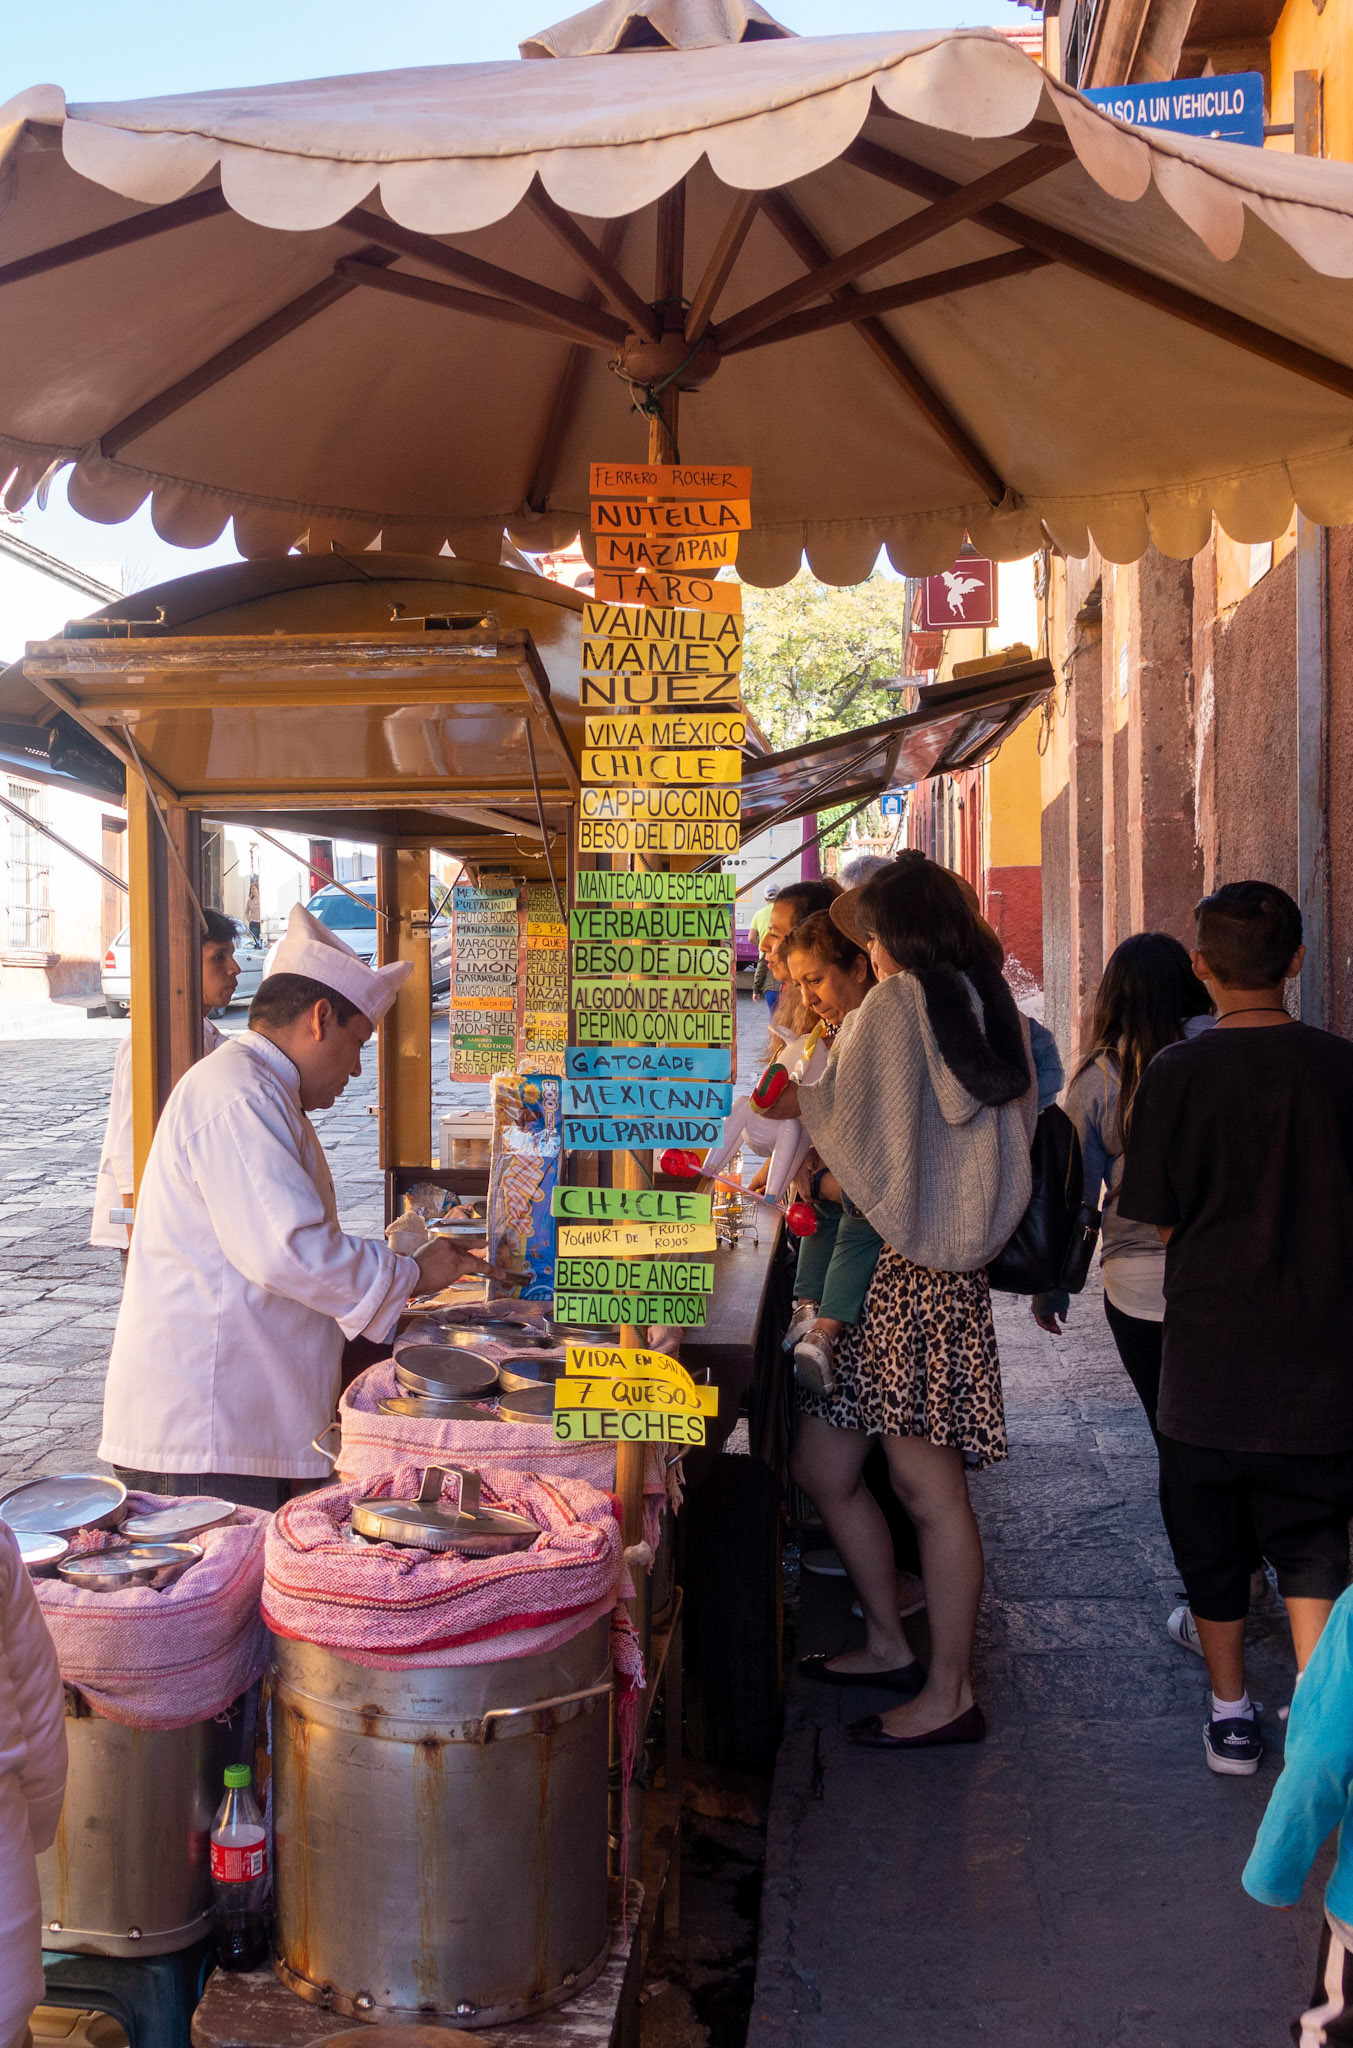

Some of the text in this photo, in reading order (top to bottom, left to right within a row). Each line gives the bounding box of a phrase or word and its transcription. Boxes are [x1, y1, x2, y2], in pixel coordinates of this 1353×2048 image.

[1097, 99, 1134, 124] PASO
[1137, 99, 1147, 123] A
[1150, 97, 1170, 122] UN
[595, 467, 738, 488] FERRERO ROCHER
[598, 504, 741, 527] NUTELLA
[609, 538, 727, 567] MAZAPAN
[604, 573, 713, 604] TARO
[587, 605, 740, 642] VAINILLA
[583, 642, 741, 671] MAMEY
[581, 673, 738, 704] NUEZ
[589, 717, 746, 745] VIVA MÉXICO
[591, 754, 716, 779] CHICLE
[583, 789, 740, 817] CAPPUCCINO
[581, 823, 738, 850] BESO DEL DIABLO
[457, 888, 513, 898] MEXICANA
[528, 888, 566, 899] YERBB
[578, 872, 735, 901] MANTECADO ESPECIAL
[456, 900, 511, 910] PULPARINDO
[457, 912, 517, 922] FRUTOS ROJOS
[533, 924, 542, 933] 3
[573, 910, 729, 937] YERBABUENA
[457, 926, 516, 934] MANDARINA
[457, 948, 517, 959] ZAPOTE
[533, 938, 537, 947] 7
[527, 949, 547, 960] BESO
[549, 950, 559, 961] DE
[575, 946, 729, 976] BESO DE DIOS
[456, 962, 517, 973] LIMÓN
[527, 963, 557, 974] PETALOS
[456, 986, 516, 997] MANGO CON CHILE
[575, 983, 729, 1009] ALGODÓN DE AZÚCAR
[457, 1010, 517, 1023] RED BULL
[526, 1001, 546, 1011] ELOTE
[455, 1023, 515, 1036] MONSTER
[579, 1011, 731, 1040] PEPINO CON CHILE
[455, 1051, 516, 1063] 5 LECHES
[526, 1040, 567, 1051] GANS
[455, 1063, 516, 1074] BESO DEL DIAO
[572, 1052, 694, 1072] GATORADE
[543, 1081, 557, 1109] 500
[570, 1084, 723, 1114] MEXICANA
[566, 1122, 720, 1143] PULPARINDO
[560, 1190, 697, 1220] CHICLE
[563, 1223, 696, 1246] YOGHURT DE FRUTOS
[655, 1237, 688, 1248] ROJOS
[557, 1261, 711, 1293] BESO DE ANGEL
[556, 1296, 705, 1324] PETALOS DE ROSA
[572, 1349, 678, 1374] VIDA EN SAN
[574, 1382, 594, 1404] 7
[556, 1413, 704, 1442] 5 LECHES
